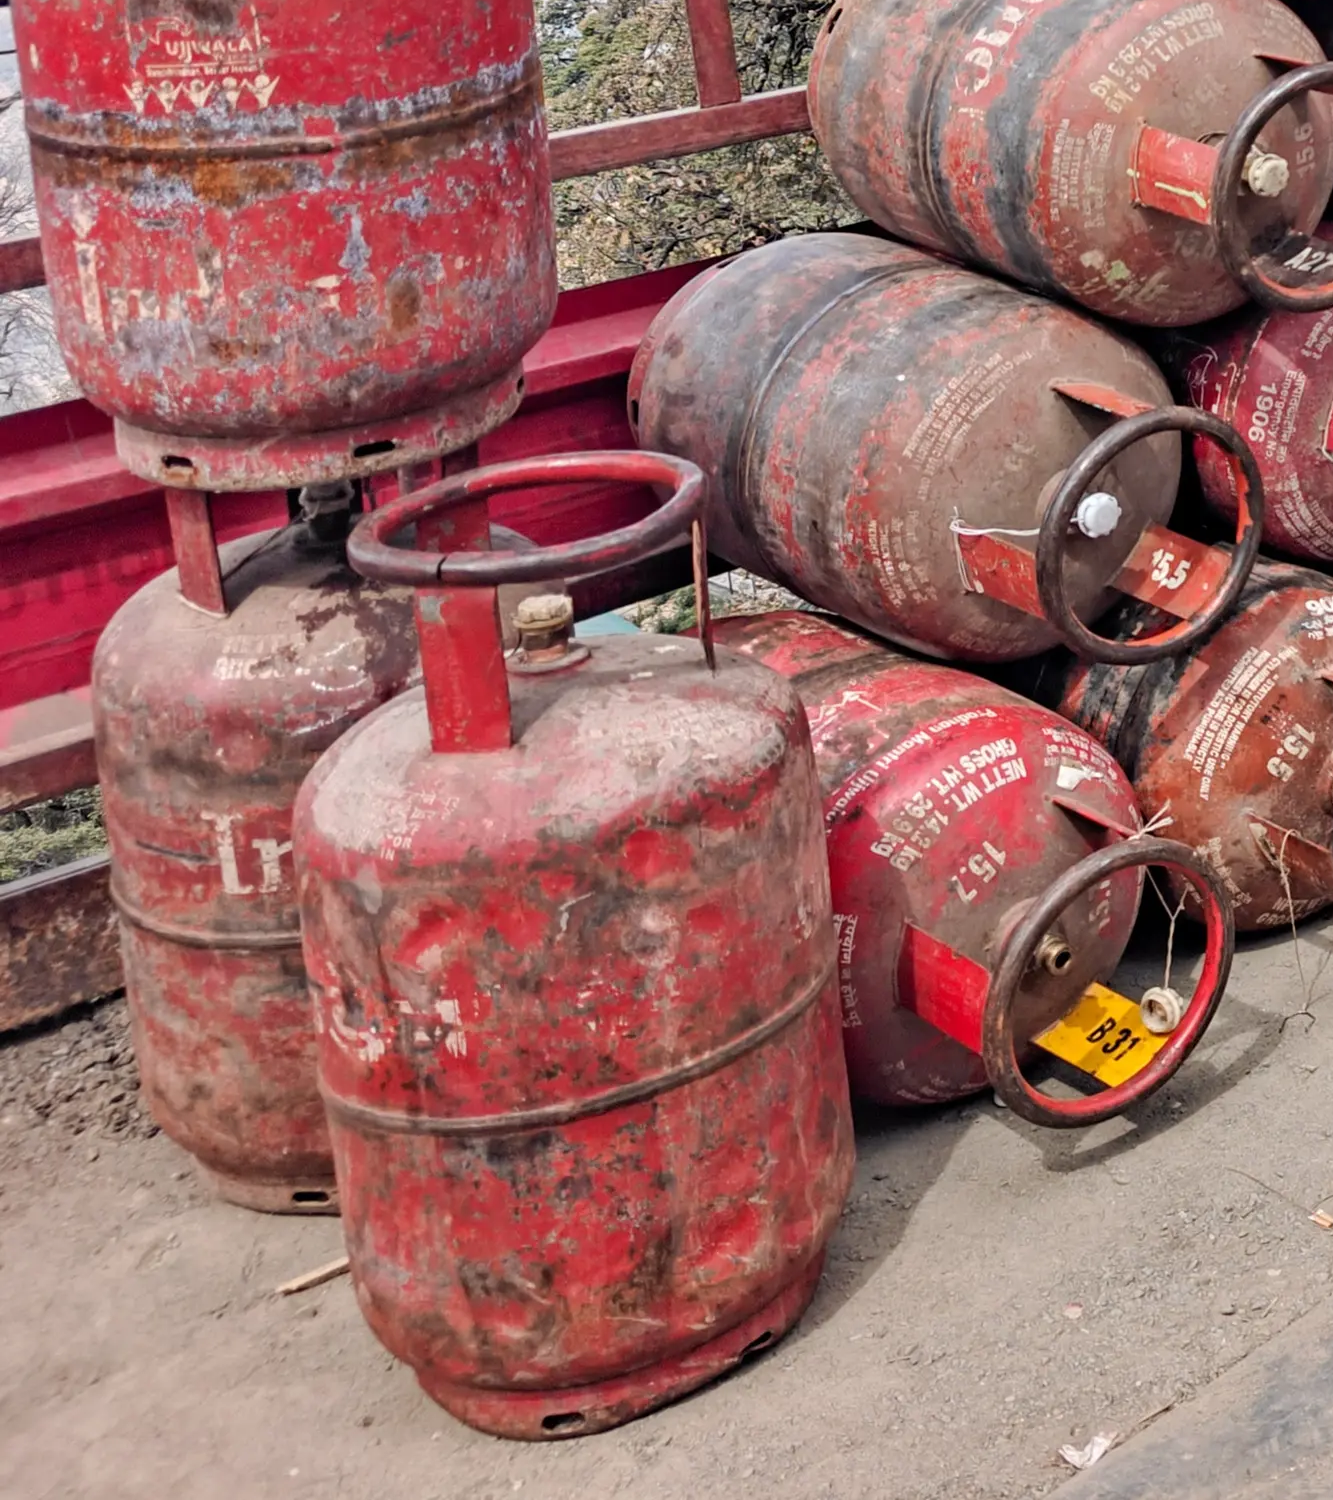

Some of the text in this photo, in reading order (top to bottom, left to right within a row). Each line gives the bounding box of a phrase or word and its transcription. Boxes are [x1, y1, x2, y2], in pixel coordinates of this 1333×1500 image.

[1163, 3, 1214, 31] GROSS
[1180, 19, 1224, 46] NETT
[1089, 75, 1115, 101] kg
[1123, 56, 1158, 94] 14.2
[1103, 87, 1134, 115] kg
[1249, 385, 1276, 443] 1906
[1265, 371, 1296, 460] Emergency No.
[876, 728, 931, 773] Mantri
[958, 736, 1019, 773] GROSS
[1264, 722, 1313, 784] 15.5
[886, 758, 1029, 875] NETT WT. 14.2 kg
[867, 829, 899, 865] kg
[945, 839, 1009, 903] 15.7
